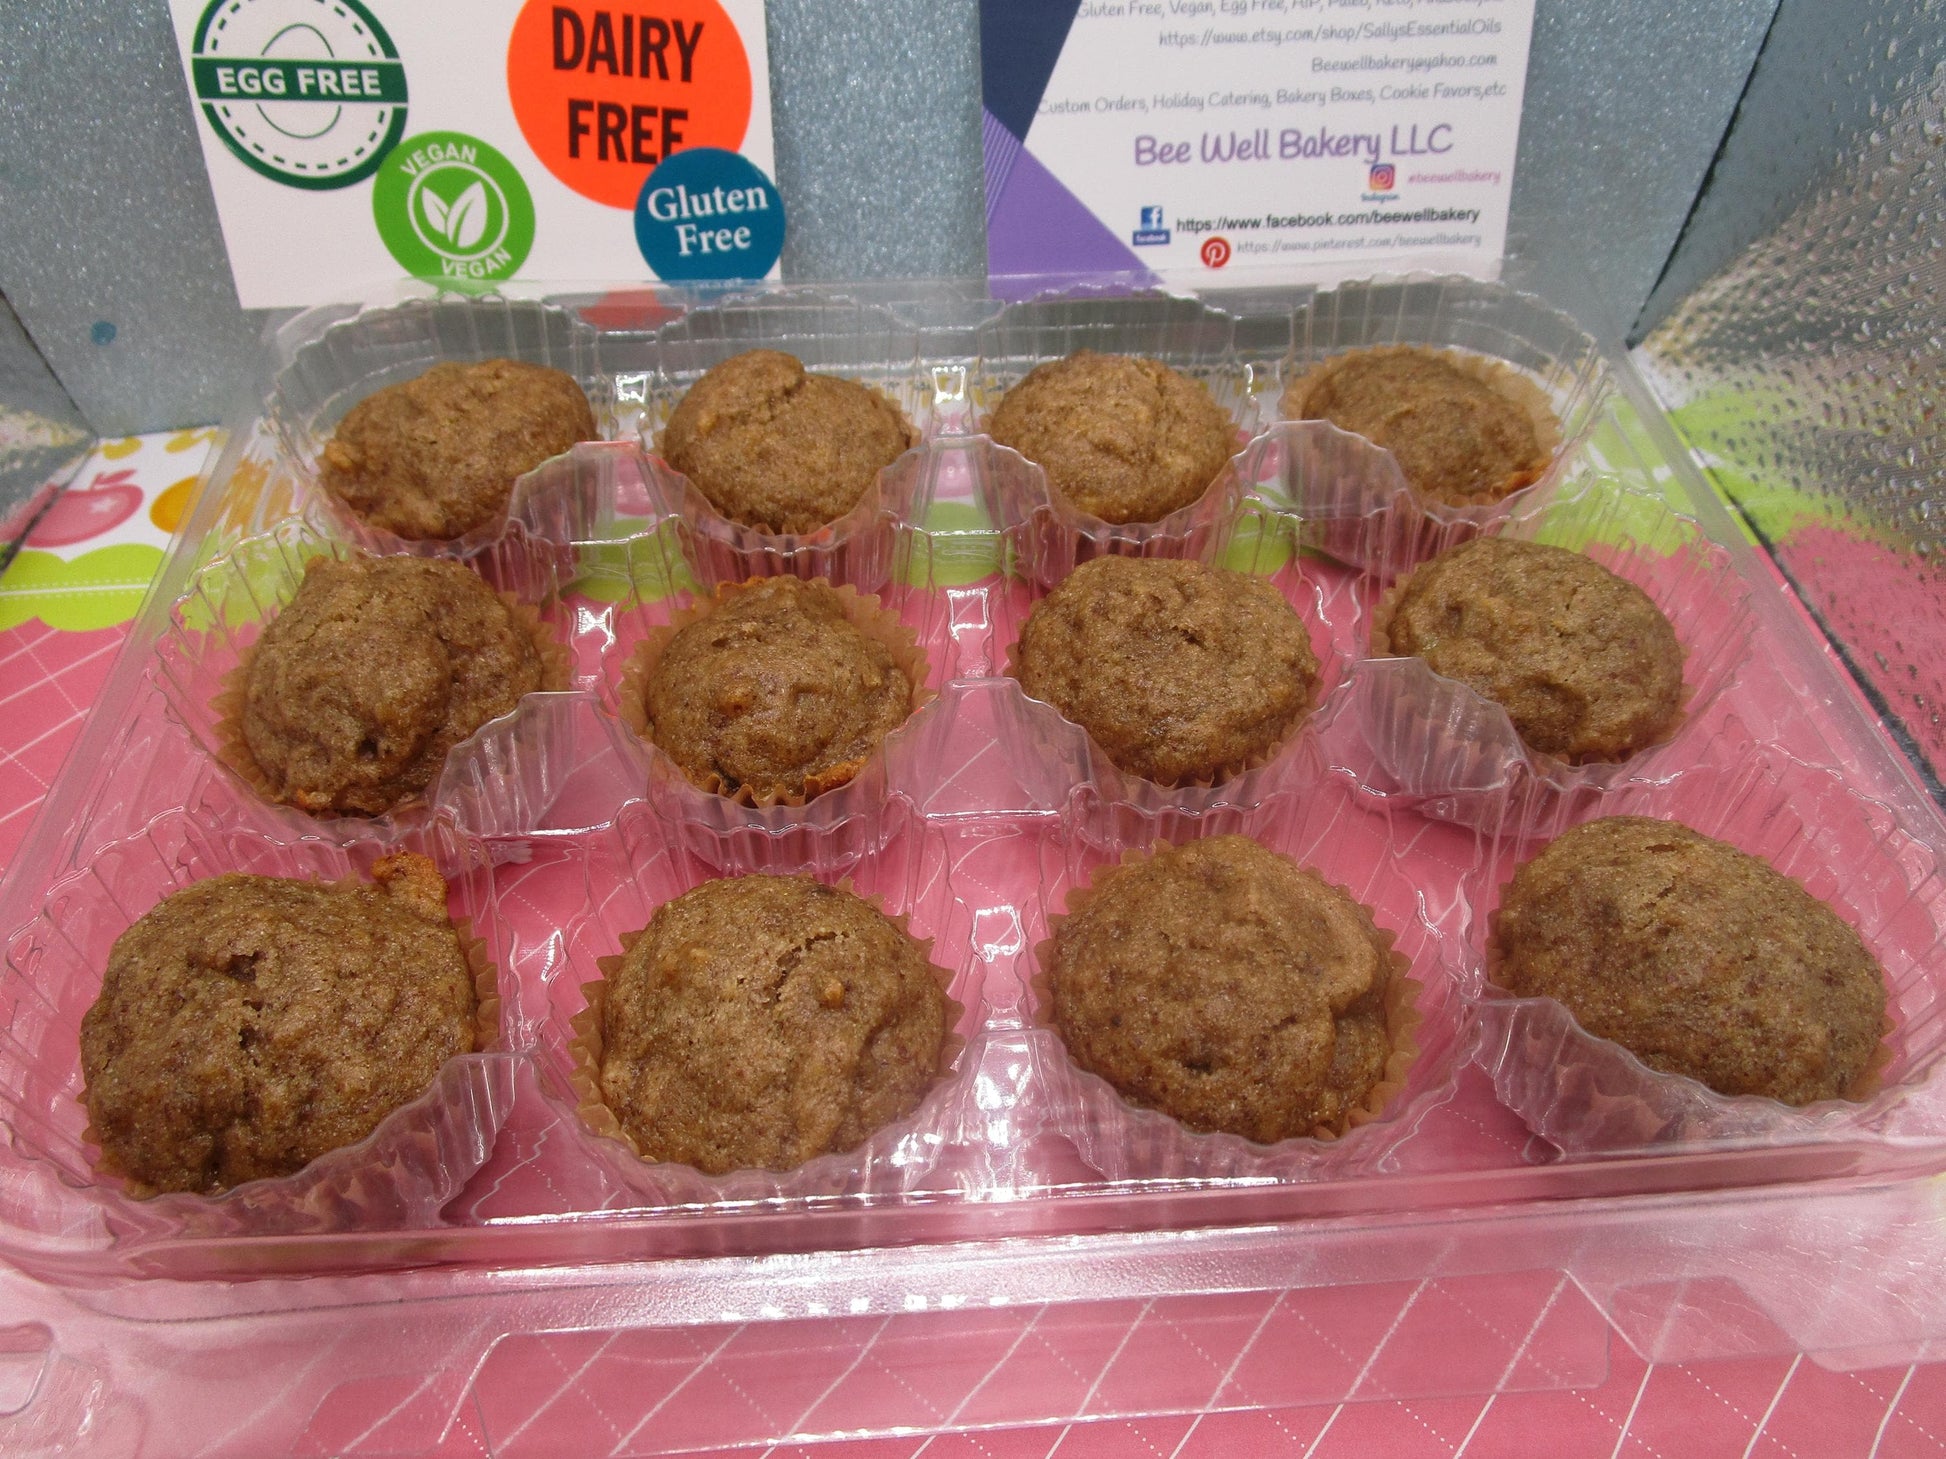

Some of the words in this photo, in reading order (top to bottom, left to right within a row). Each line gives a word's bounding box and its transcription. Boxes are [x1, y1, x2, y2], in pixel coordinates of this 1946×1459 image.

[1078, 1, 1124, 18] Gluten
[1129, 0, 1165, 18] Free,
[1169, 0, 1216, 16] Vegan,
[1220, 0, 1247, 15] Egg
[552, 6, 704, 83] DAIRY
[216, 67, 287, 95] EGG
[296, 68, 382, 96] FREE
[1037, 97, 1090, 115] Custom
[1094, 95, 1149, 113] Orders,
[1152, 90, 1205, 112] Holiday
[1208, 90, 1272, 109] Catering,
[1276, 87, 1327, 107] Bakery
[1330, 86, 1376, 104] Boxes,
[1379, 83, 1430, 100] Cookie
[567, 97, 689, 164] FREE
[1134, 134, 1192, 166] Bee
[1200, 128, 1271, 164] Well
[1278, 126, 1382, 165] Bakery
[1389, 123, 1454, 156] LLC
[399, 142, 478, 176] VEGAN
[647, 184, 769, 222] Gluten
[1176, 206, 1481, 235] https://www.facebook.com/beewellbakery
[674, 223, 752, 257] Free
[441, 246, 513, 279] VEGAN
